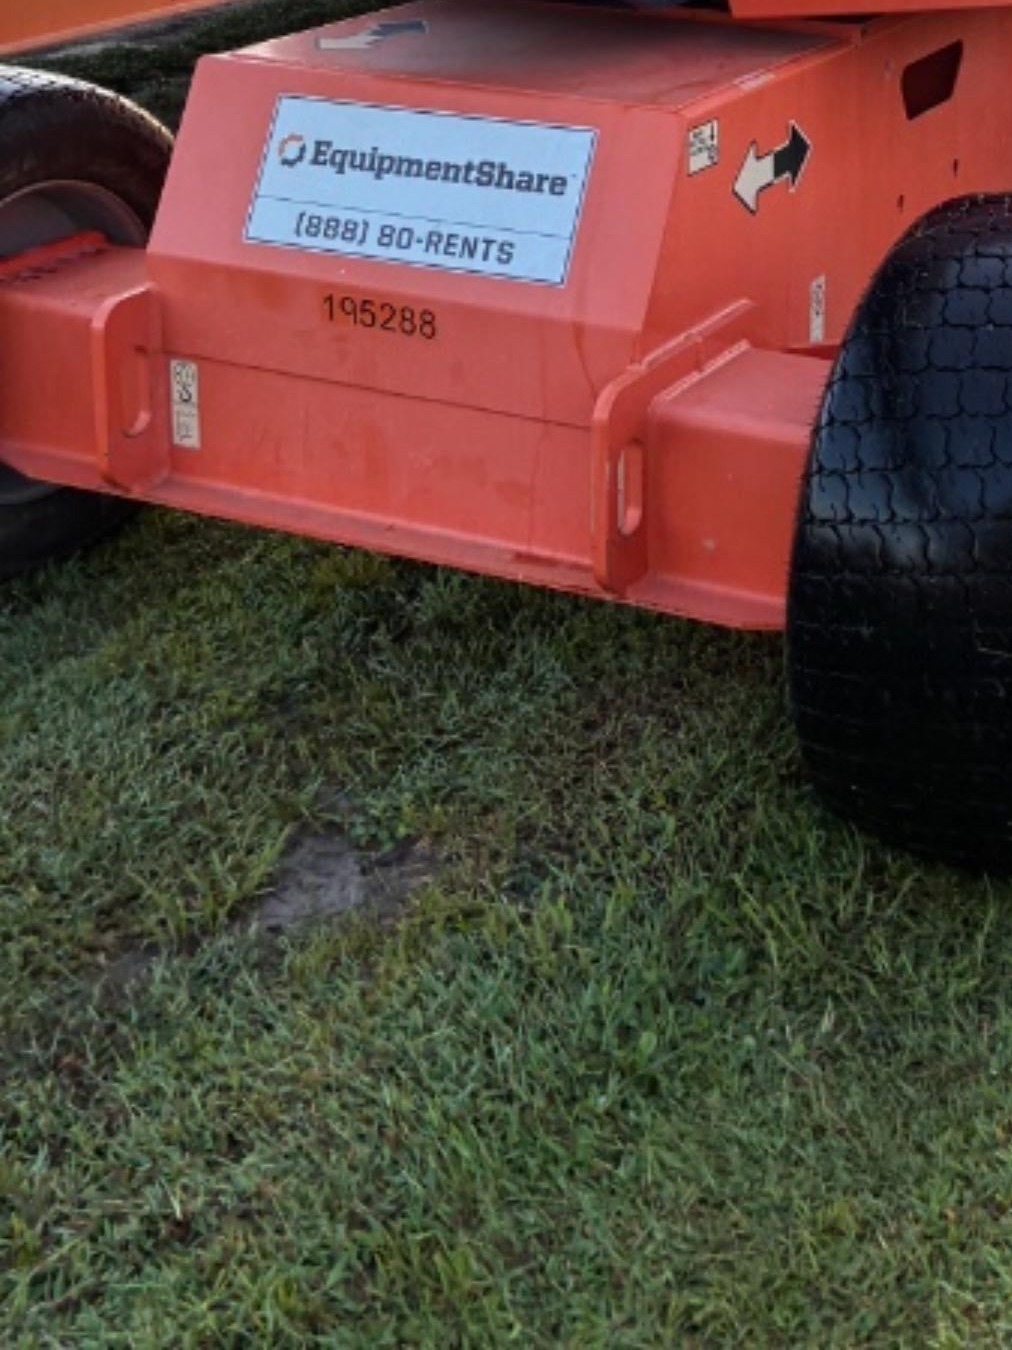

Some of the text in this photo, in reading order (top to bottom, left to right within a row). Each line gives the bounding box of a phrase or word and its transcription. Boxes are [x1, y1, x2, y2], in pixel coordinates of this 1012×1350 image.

[309, 139, 568, 197] EquipmentShare
[293, 210, 515, 265] (888) 80-RENTS
[322, 292, 437, 340] 195288
